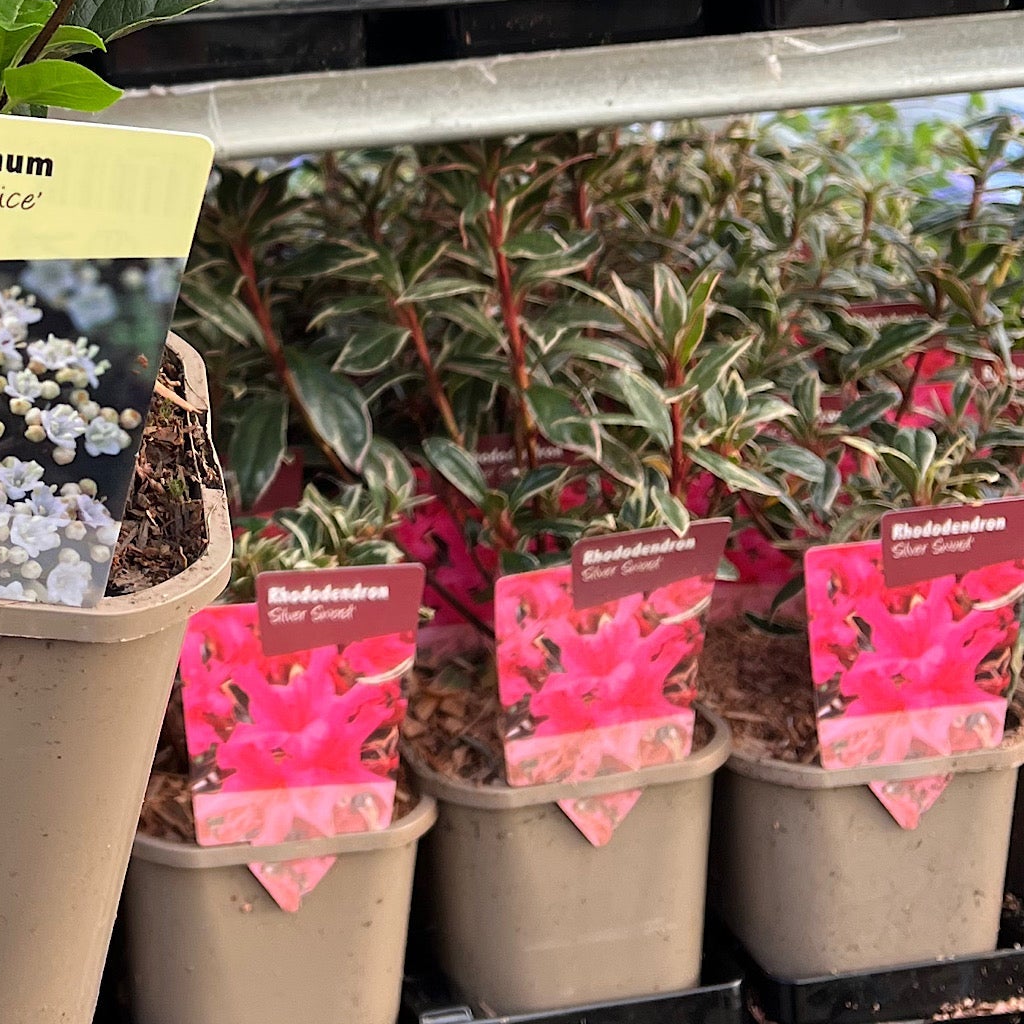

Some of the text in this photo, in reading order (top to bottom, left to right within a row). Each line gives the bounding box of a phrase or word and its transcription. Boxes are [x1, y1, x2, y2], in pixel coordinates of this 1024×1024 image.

[890, 515, 1007, 541] Rhododendron
[582, 537, 697, 567] Rhododendron
[266, 582, 390, 605] Rhododendron
